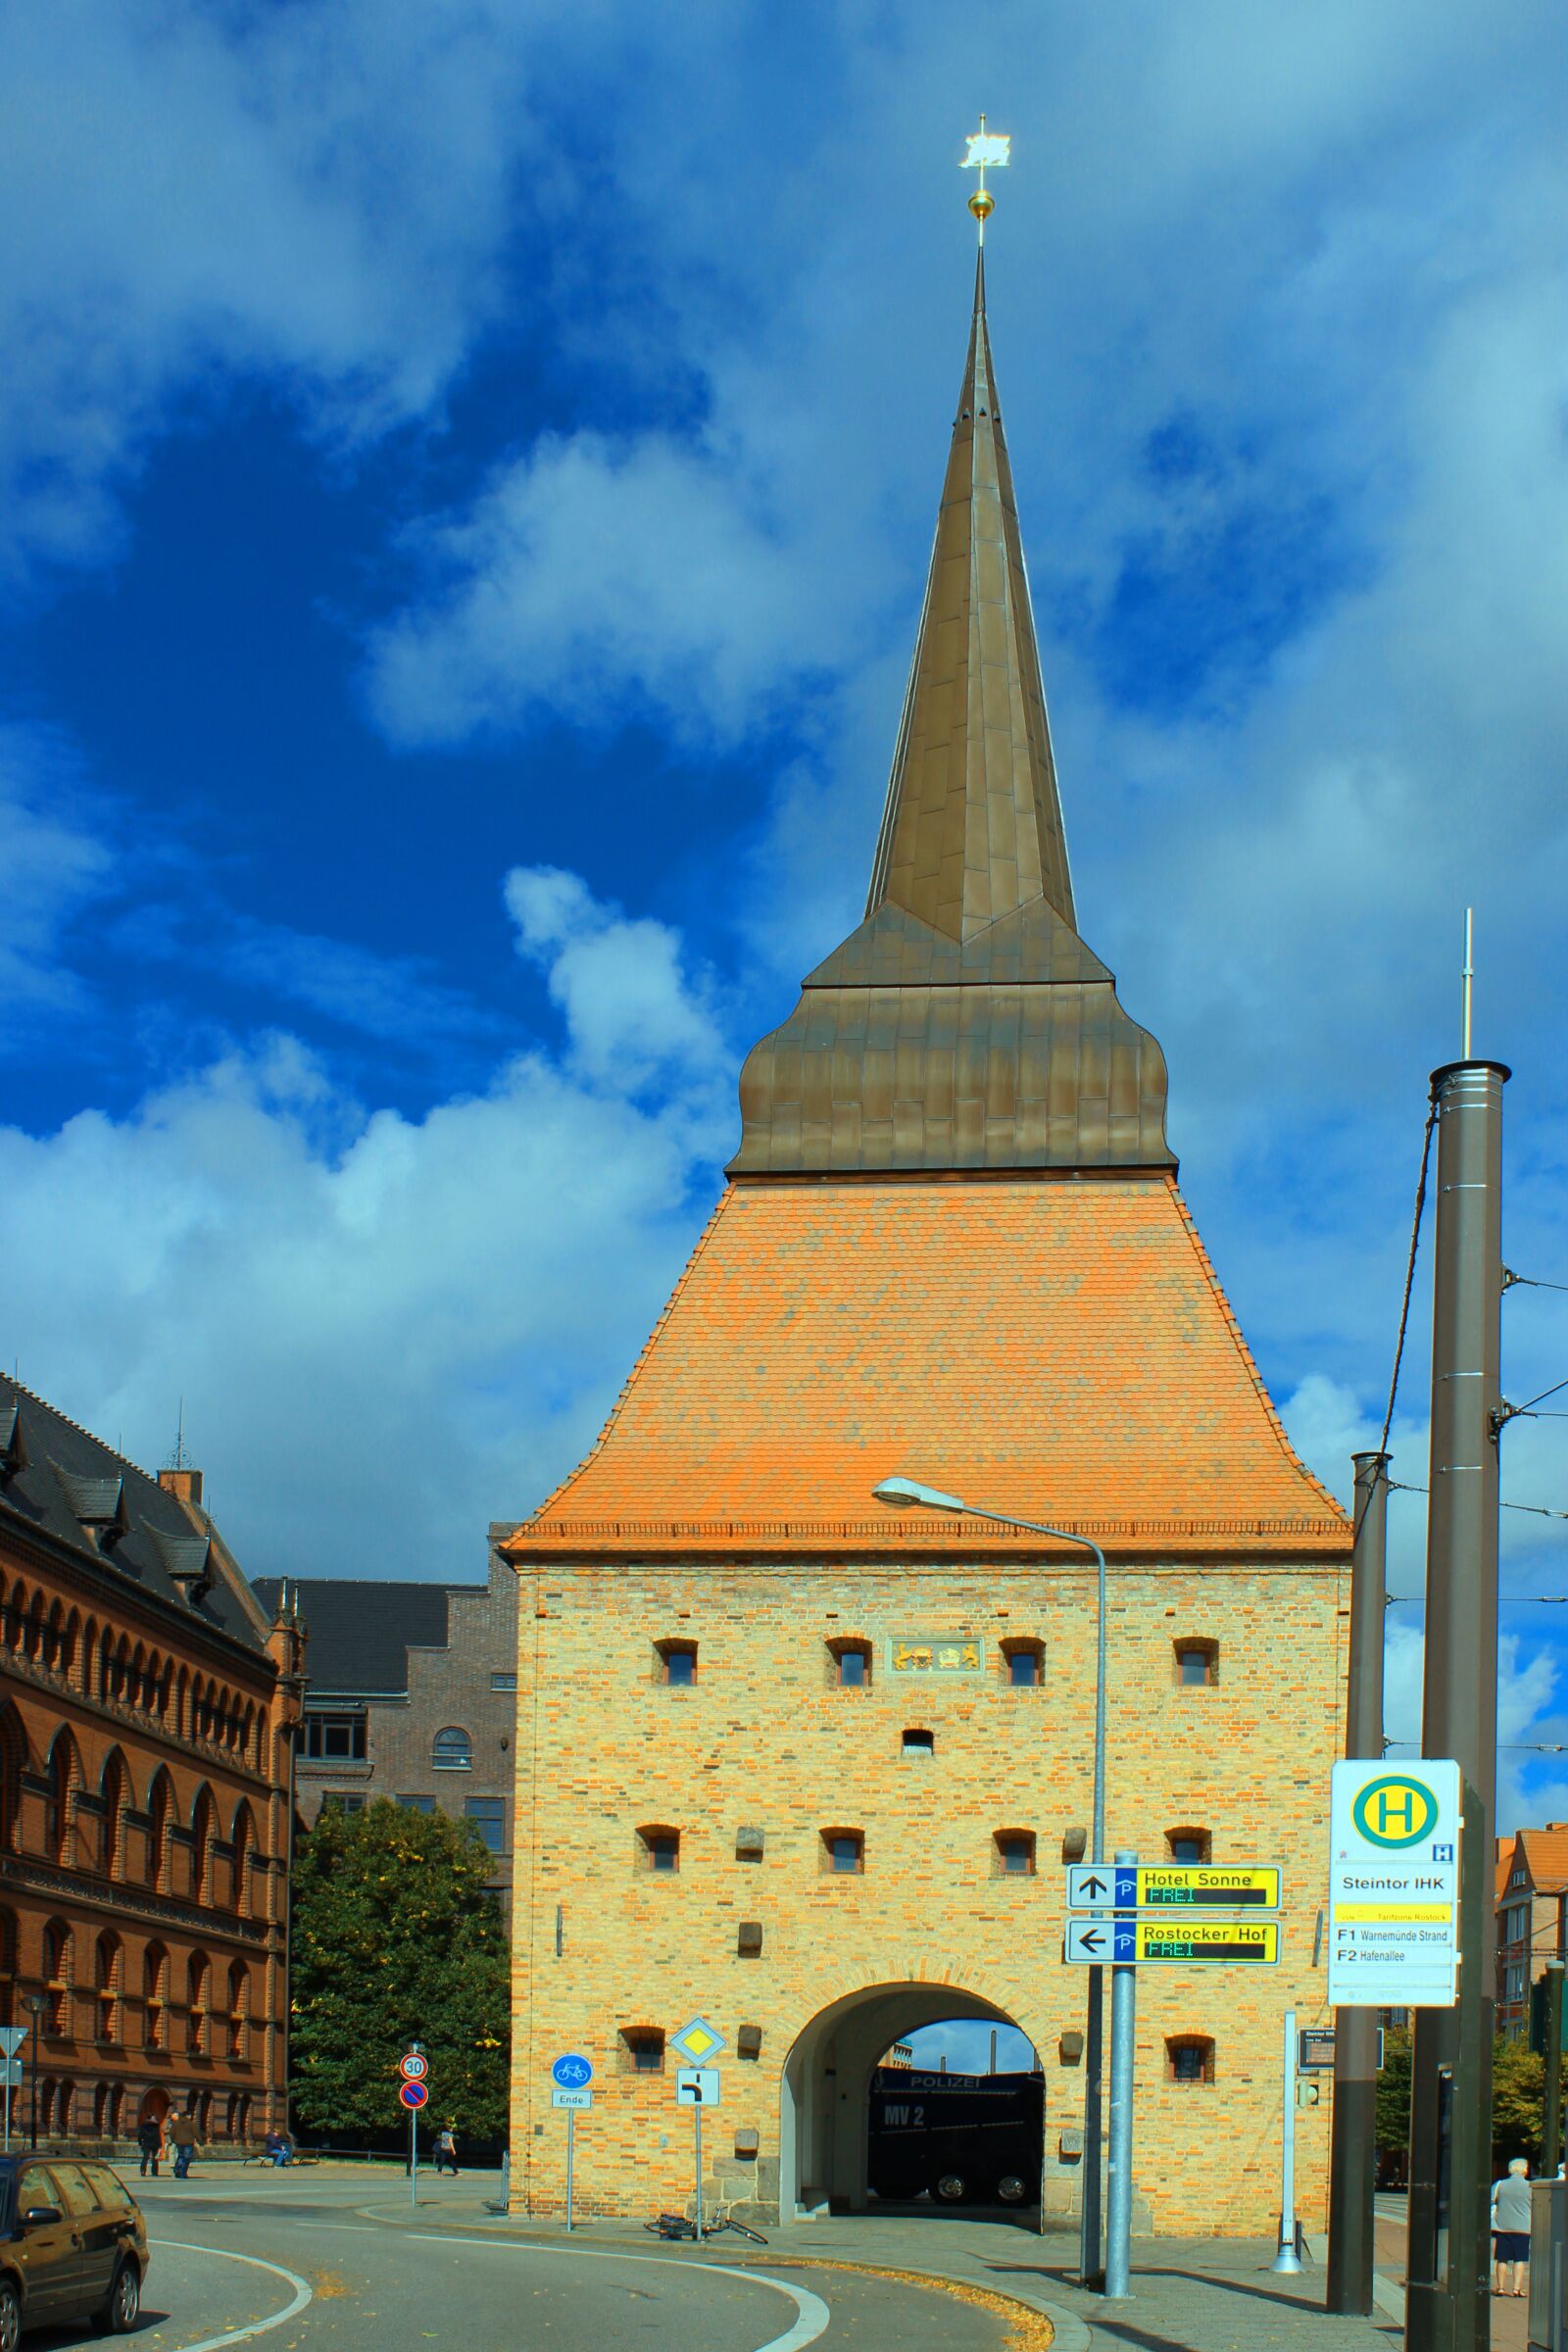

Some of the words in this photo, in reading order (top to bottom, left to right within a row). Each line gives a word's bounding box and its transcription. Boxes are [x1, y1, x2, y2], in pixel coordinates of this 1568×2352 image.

[1378, 1792, 1413, 1833] H
[1145, 1872, 1189, 1886] Hotel
[1199, 1873, 1251, 1886] Sonne
[1343, 1877, 1409, 1889] Steintor
[1415, 1878, 1445, 1889] IHK
[1121, 1885, 1132, 1896] P
[1150, 1887, 1195, 1902] FREI
[1144, 1927, 1229, 1939] Rostocker
[1239, 1928, 1267, 1940] Hof
[1338, 1929, 1355, 1940] F1
[1361, 1930, 1416, 1941] Warnemünde
[1419, 1930, 1447, 1941] Strand
[1120, 1938, 1131, 1950] P
[1149, 1941, 1194, 1956] FREI
[1337, 1949, 1357, 1961] F2
[1360, 1950, 1405, 1961] Hafenallee
[406, 2061, 422, 2074] 30
[910, 2077, 980, 2088] POLIZEI
[560, 2094, 584, 2104] Ende
[884, 2105, 909, 2126] MV
[913, 2106, 924, 2126] 2
